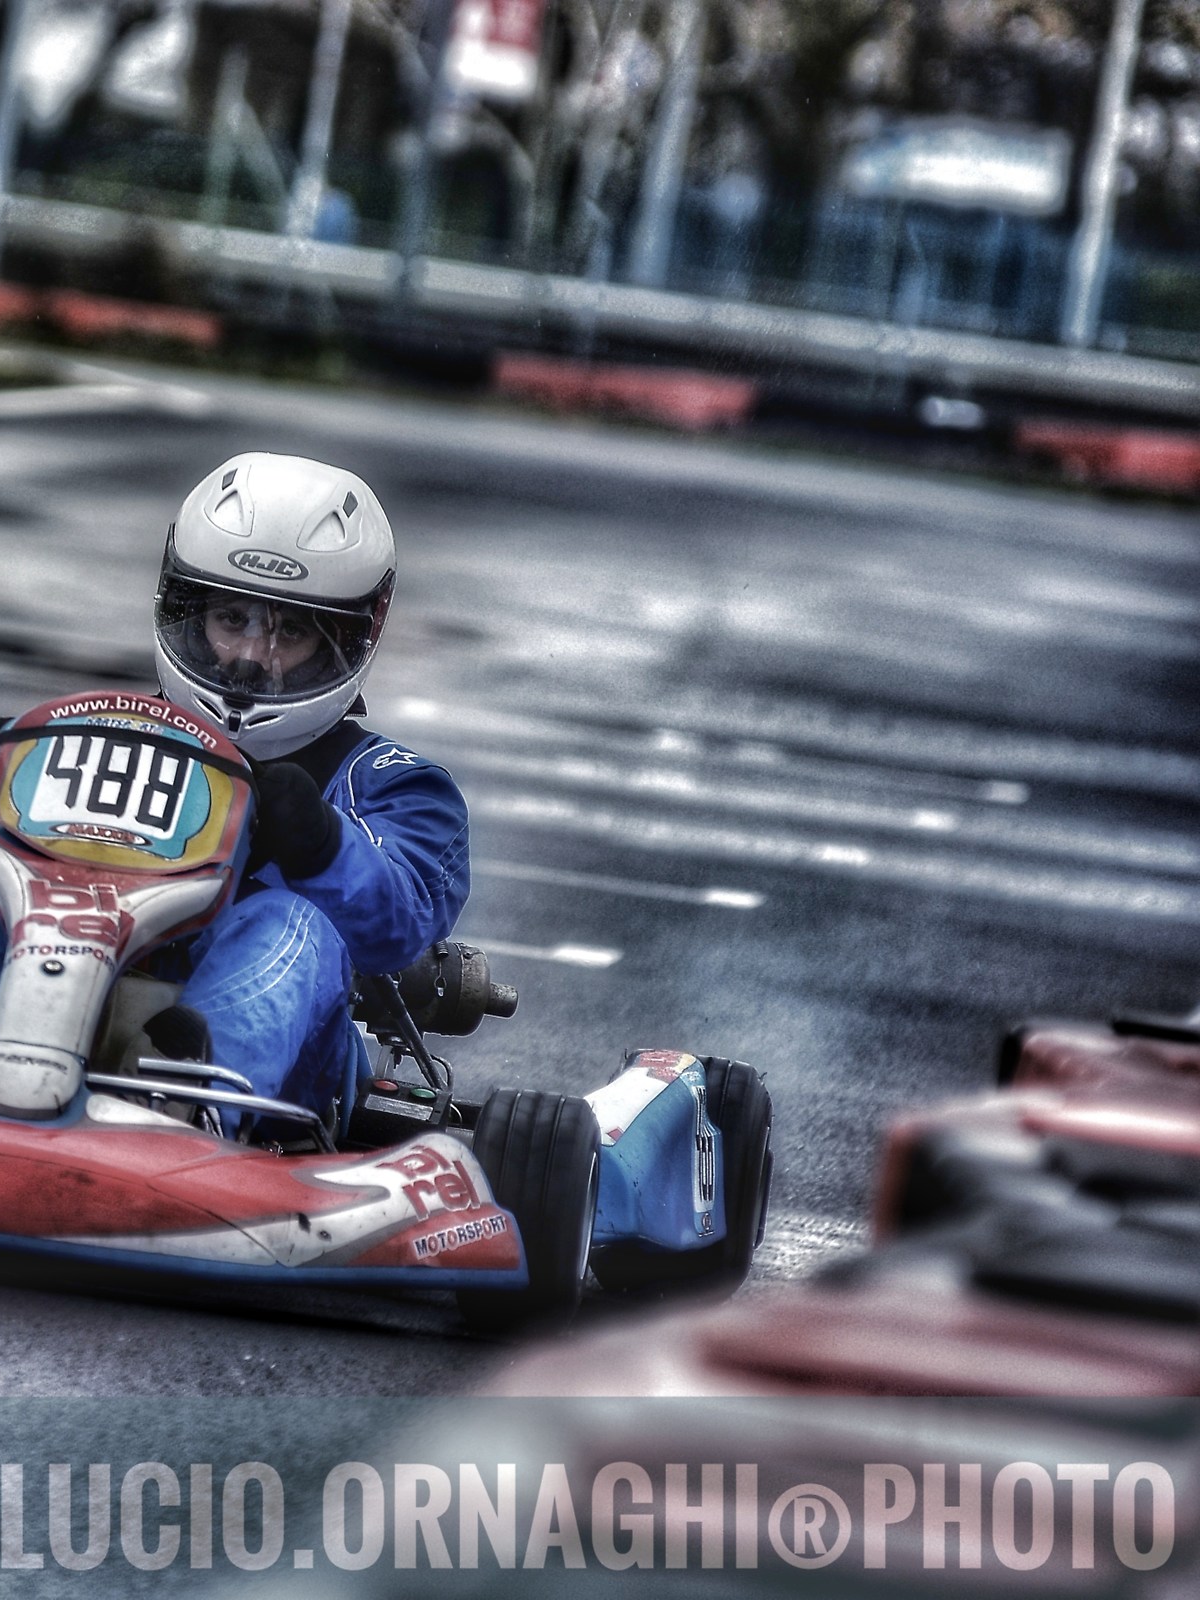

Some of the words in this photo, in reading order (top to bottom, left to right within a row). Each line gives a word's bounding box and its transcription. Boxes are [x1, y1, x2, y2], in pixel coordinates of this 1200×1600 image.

[238, 552, 298, 577] HJC
[50, 696, 218, 749] www.birel.com
[45, 734, 191, 832] 488
[414, 1216, 507, 1257] MOTORSPORT
